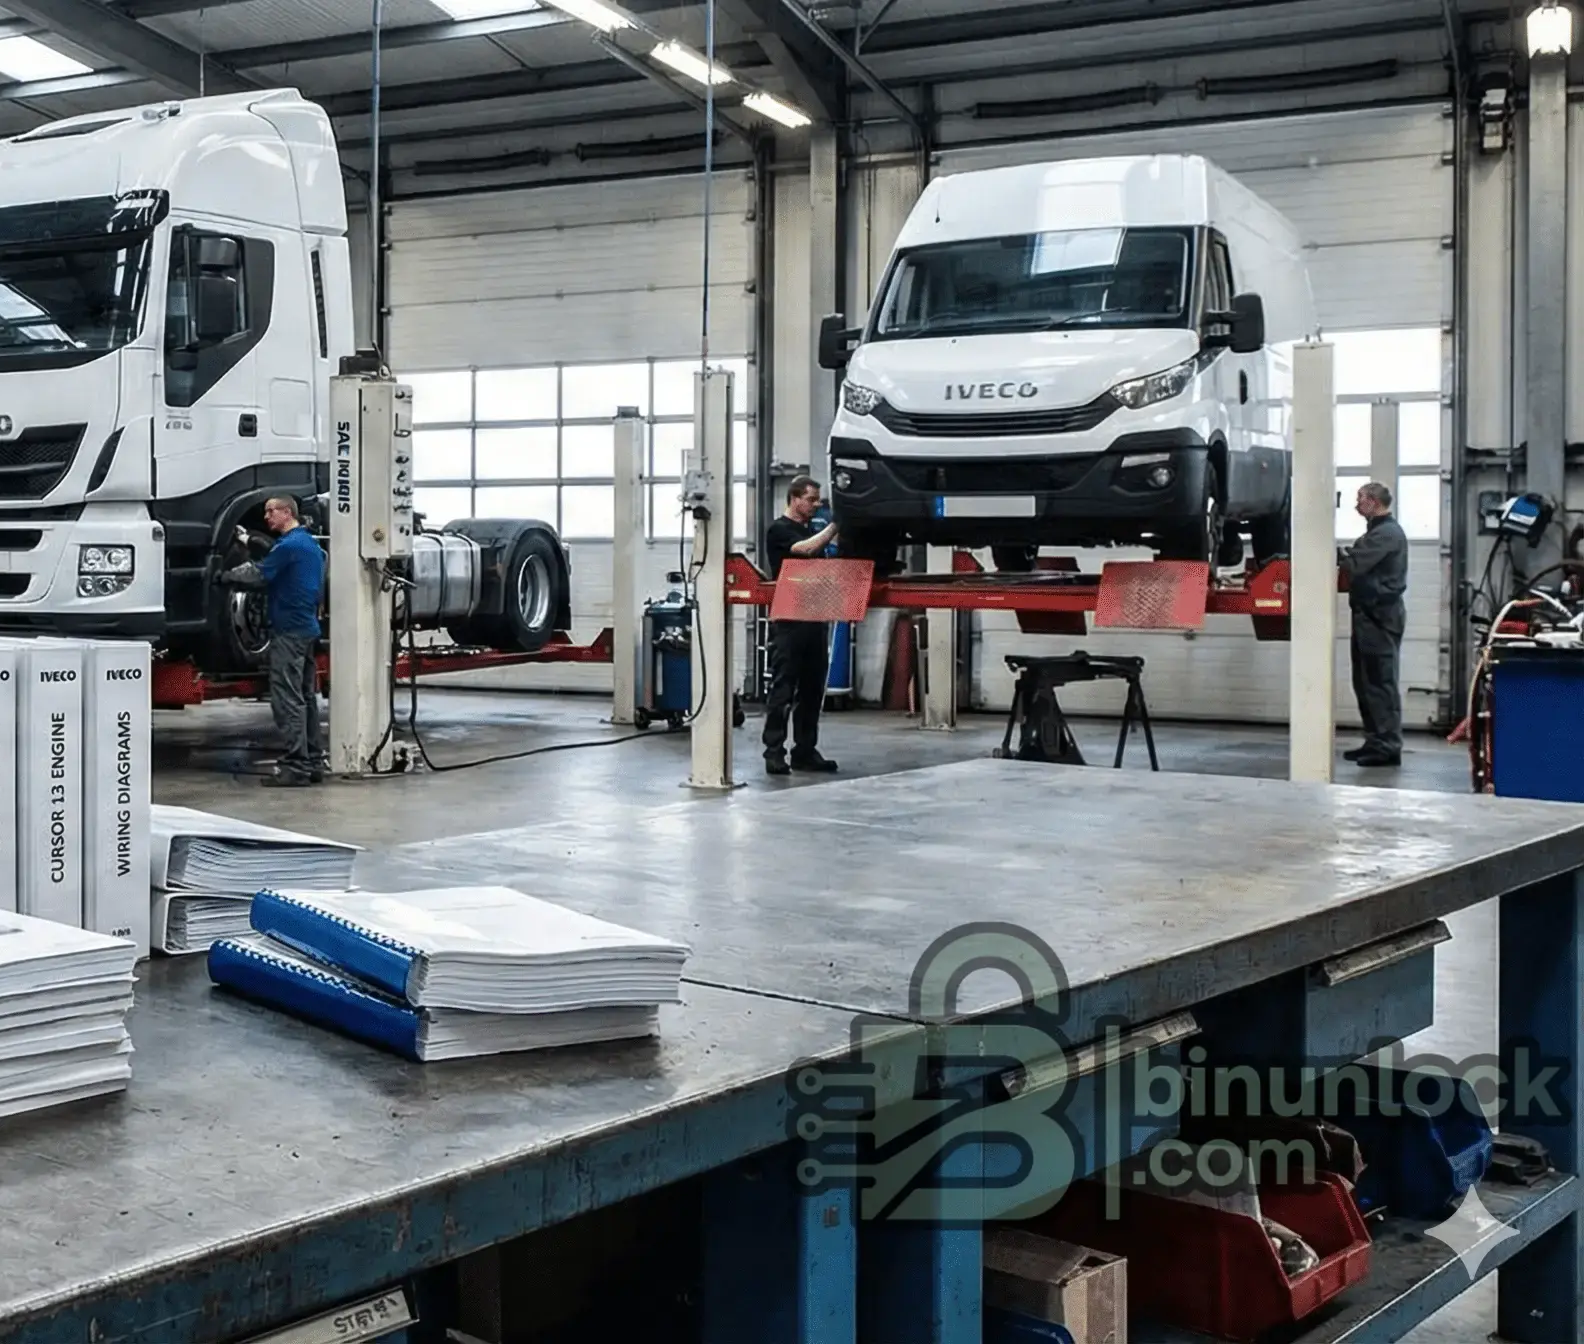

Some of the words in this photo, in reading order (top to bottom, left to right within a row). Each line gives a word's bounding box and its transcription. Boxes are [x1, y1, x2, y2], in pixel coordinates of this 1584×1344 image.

[945, 382, 1038, 400] IVECO
[40, 670, 77, 683] IVECO
[106, 669, 142, 681] IVECO
[51, 712, 65, 779] ENGINE
[118, 711, 131, 804] DIAGRAMS
[51, 784, 65, 804] 13
[51, 810, 65, 883] CURSOR
[118, 810, 131, 877] WIRING
